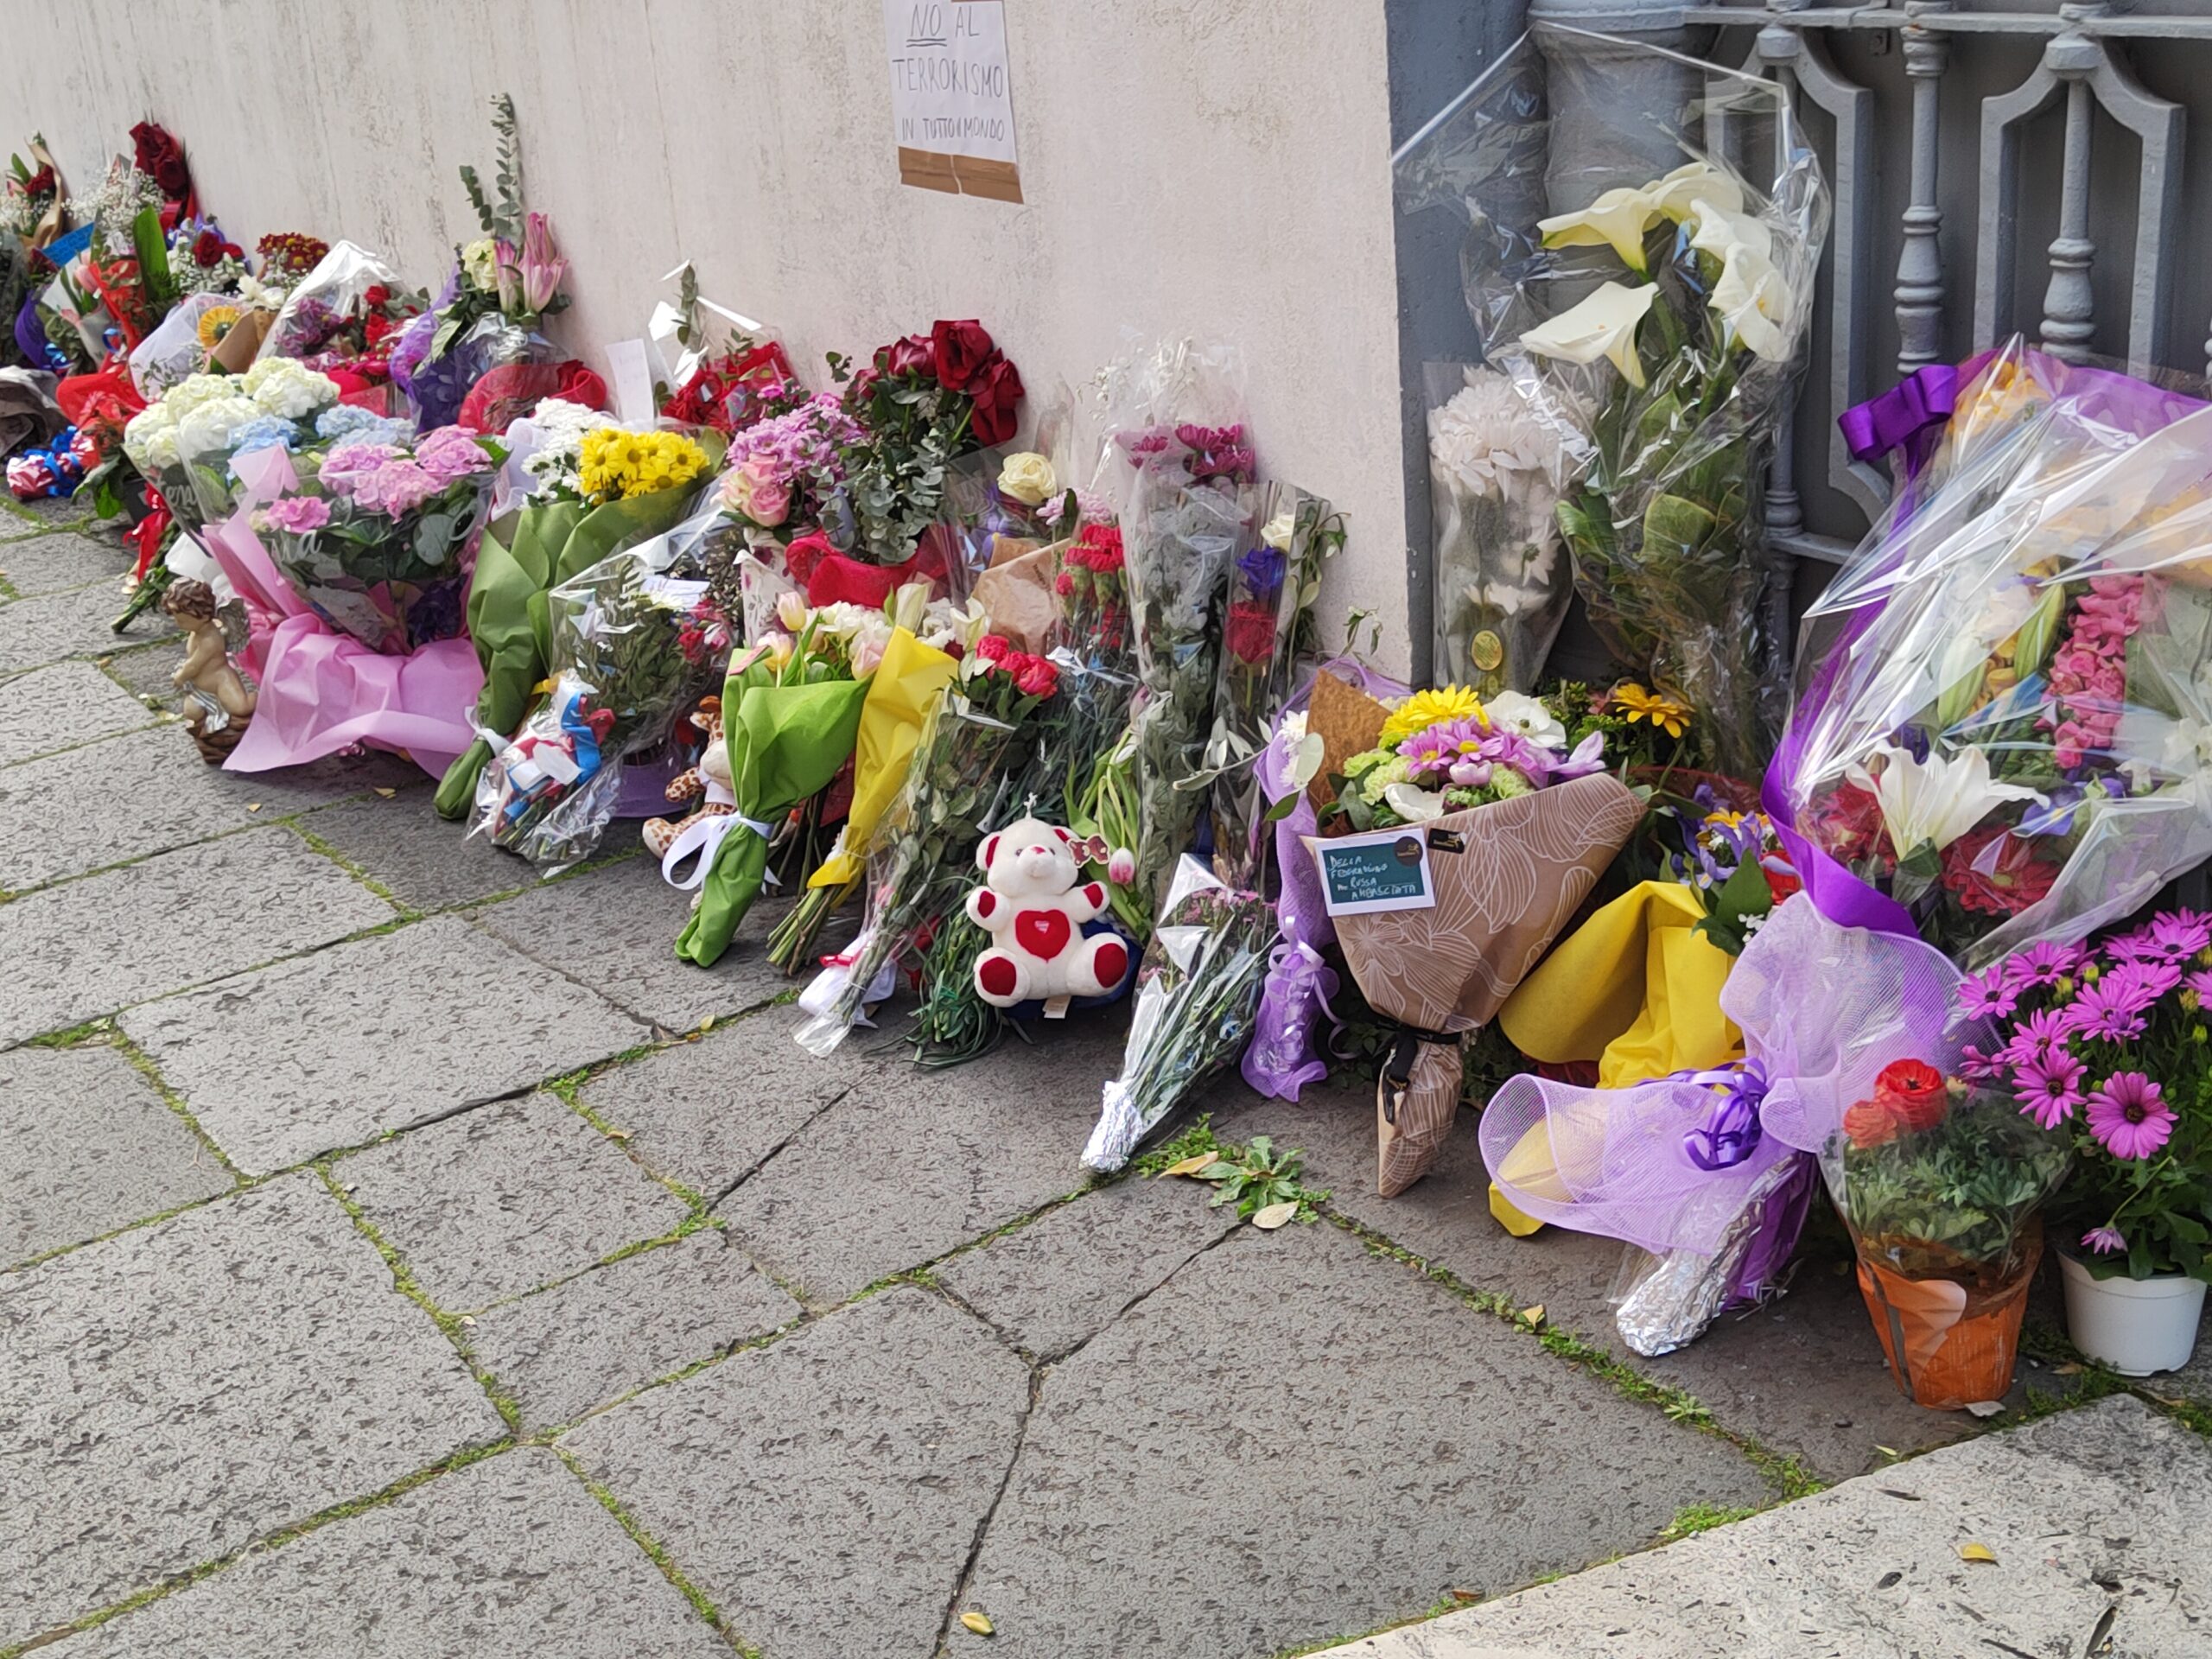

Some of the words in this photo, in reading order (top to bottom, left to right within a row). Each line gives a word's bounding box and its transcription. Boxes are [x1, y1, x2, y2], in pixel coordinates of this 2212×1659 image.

[910, 4, 942, 37] NO
[955, 5, 980, 38] AL
[892, 57, 1003, 98] TERRORISMO
[902, 118, 914, 141] IN
[1350, 875, 1377, 889] RUSSA
